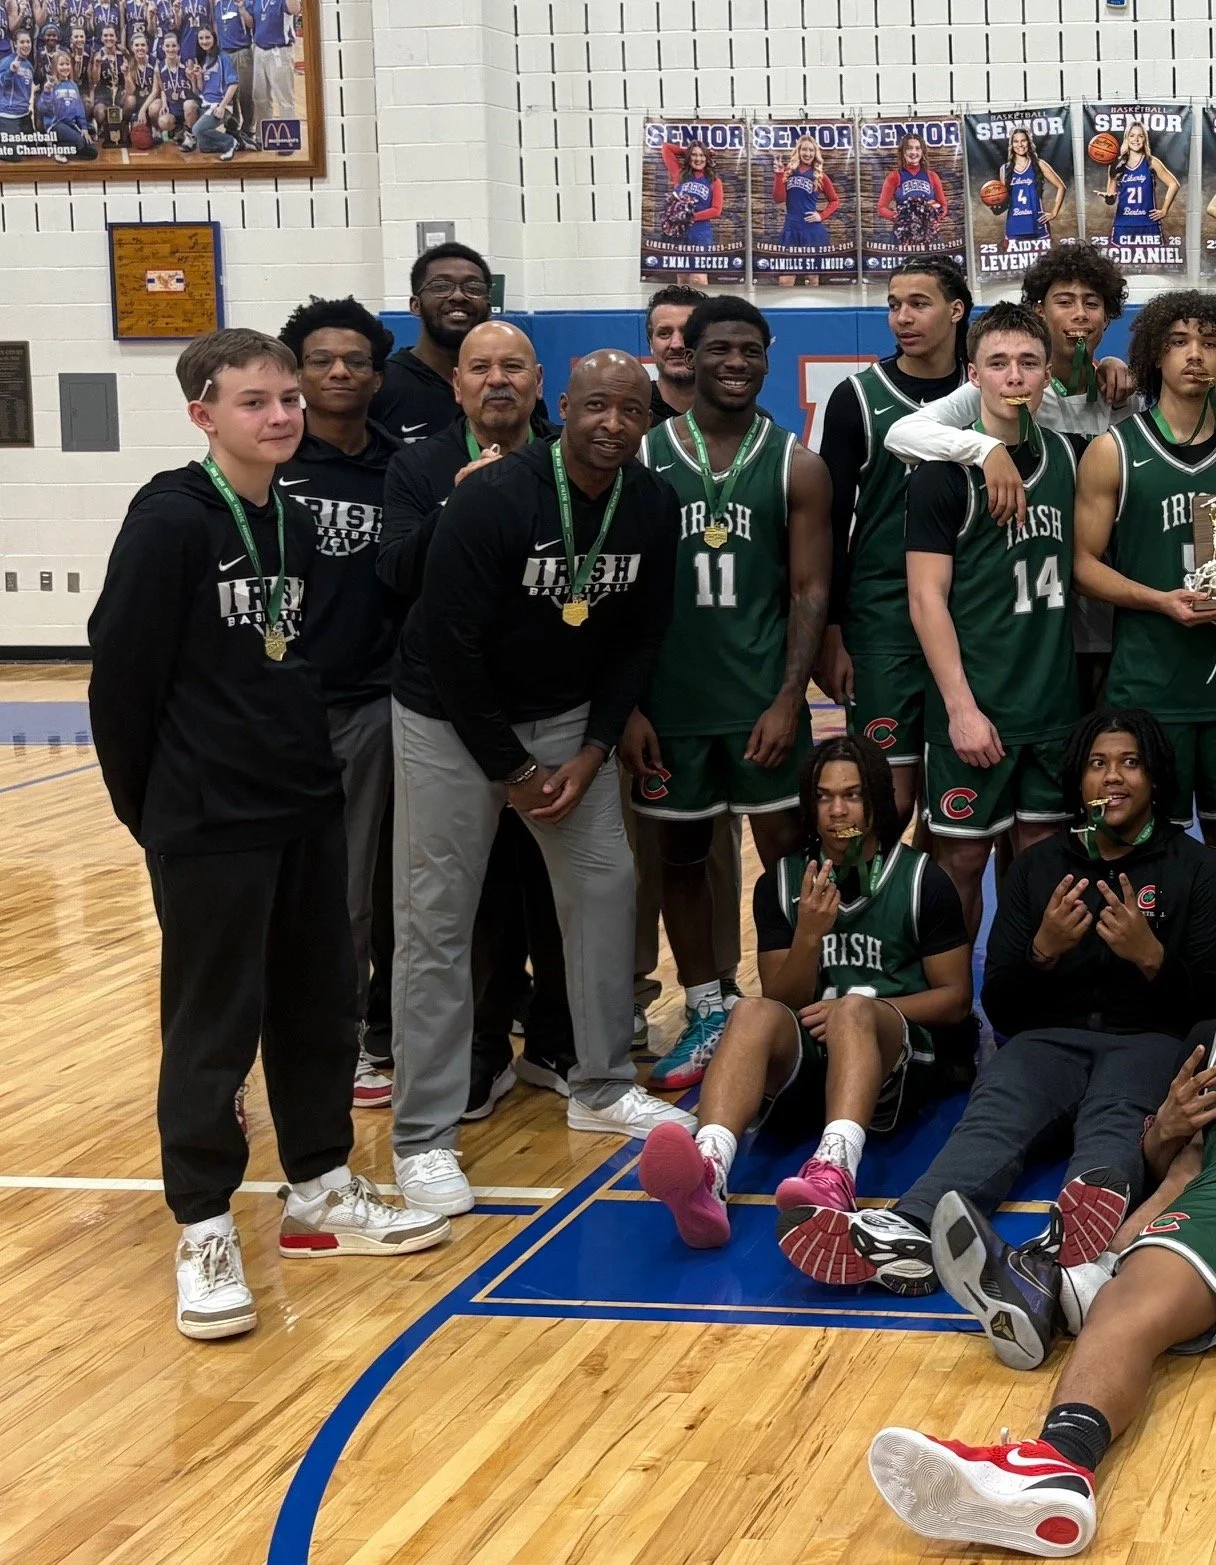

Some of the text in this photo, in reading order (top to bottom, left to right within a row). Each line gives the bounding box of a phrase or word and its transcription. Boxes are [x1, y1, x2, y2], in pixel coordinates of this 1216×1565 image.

[990, 111, 1048, 121] BASKETBALL
[1095, 113, 1182, 132] SENIOR
[0, 131, 58, 142] Basketball
[646, 124, 745, 149] SENIOR
[753, 124, 853, 149] SENIOR
[861, 121, 961, 149] SENIOR
[16, 144, 77, 157] Champions
[1018, 189, 1028, 205] 4
[1127, 187, 1143, 204] 21
[980, 243, 998, 253] 25
[1091, 235, 1181, 246] 25 CLAIRE 26
[662, 256, 690, 268] EMMA
[770, 258, 803, 270] CAMILLE
[806, 258, 818, 270] ST.
[694, 552, 737, 608] 11
[1012, 555, 1065, 615] 14
[822, 933, 882, 971] RISH
